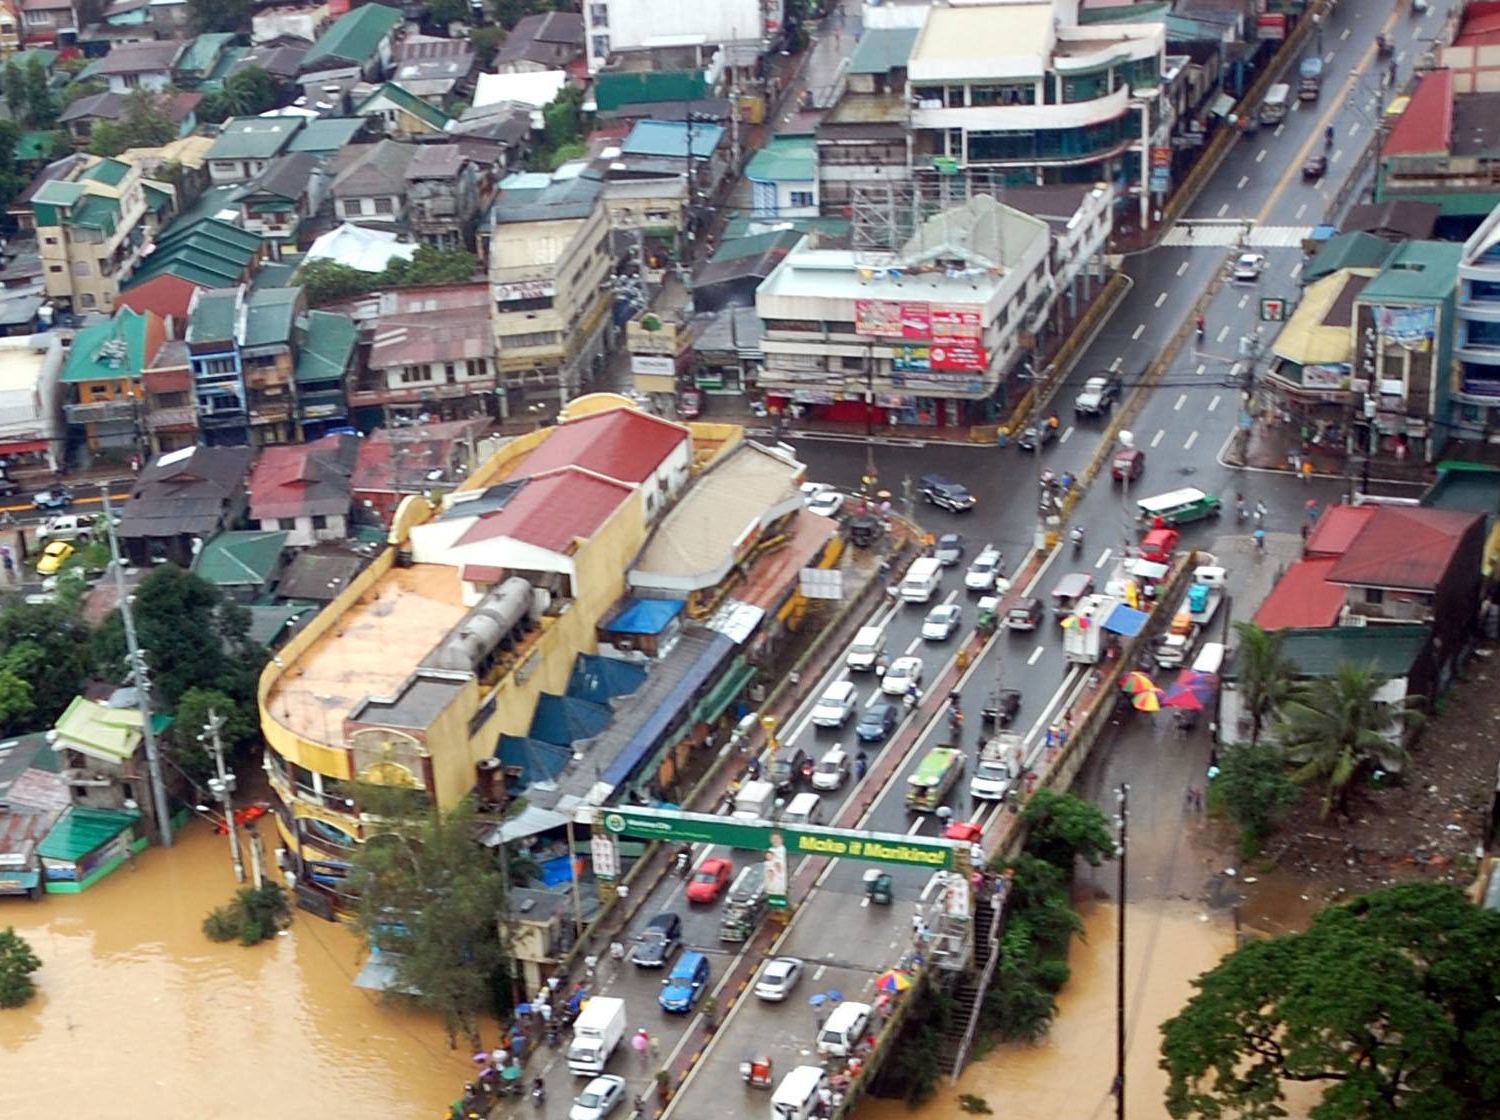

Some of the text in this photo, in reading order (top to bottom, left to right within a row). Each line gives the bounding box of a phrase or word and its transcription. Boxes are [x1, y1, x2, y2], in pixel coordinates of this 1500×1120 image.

[799, 836, 946, 864] Make it Marikina!
